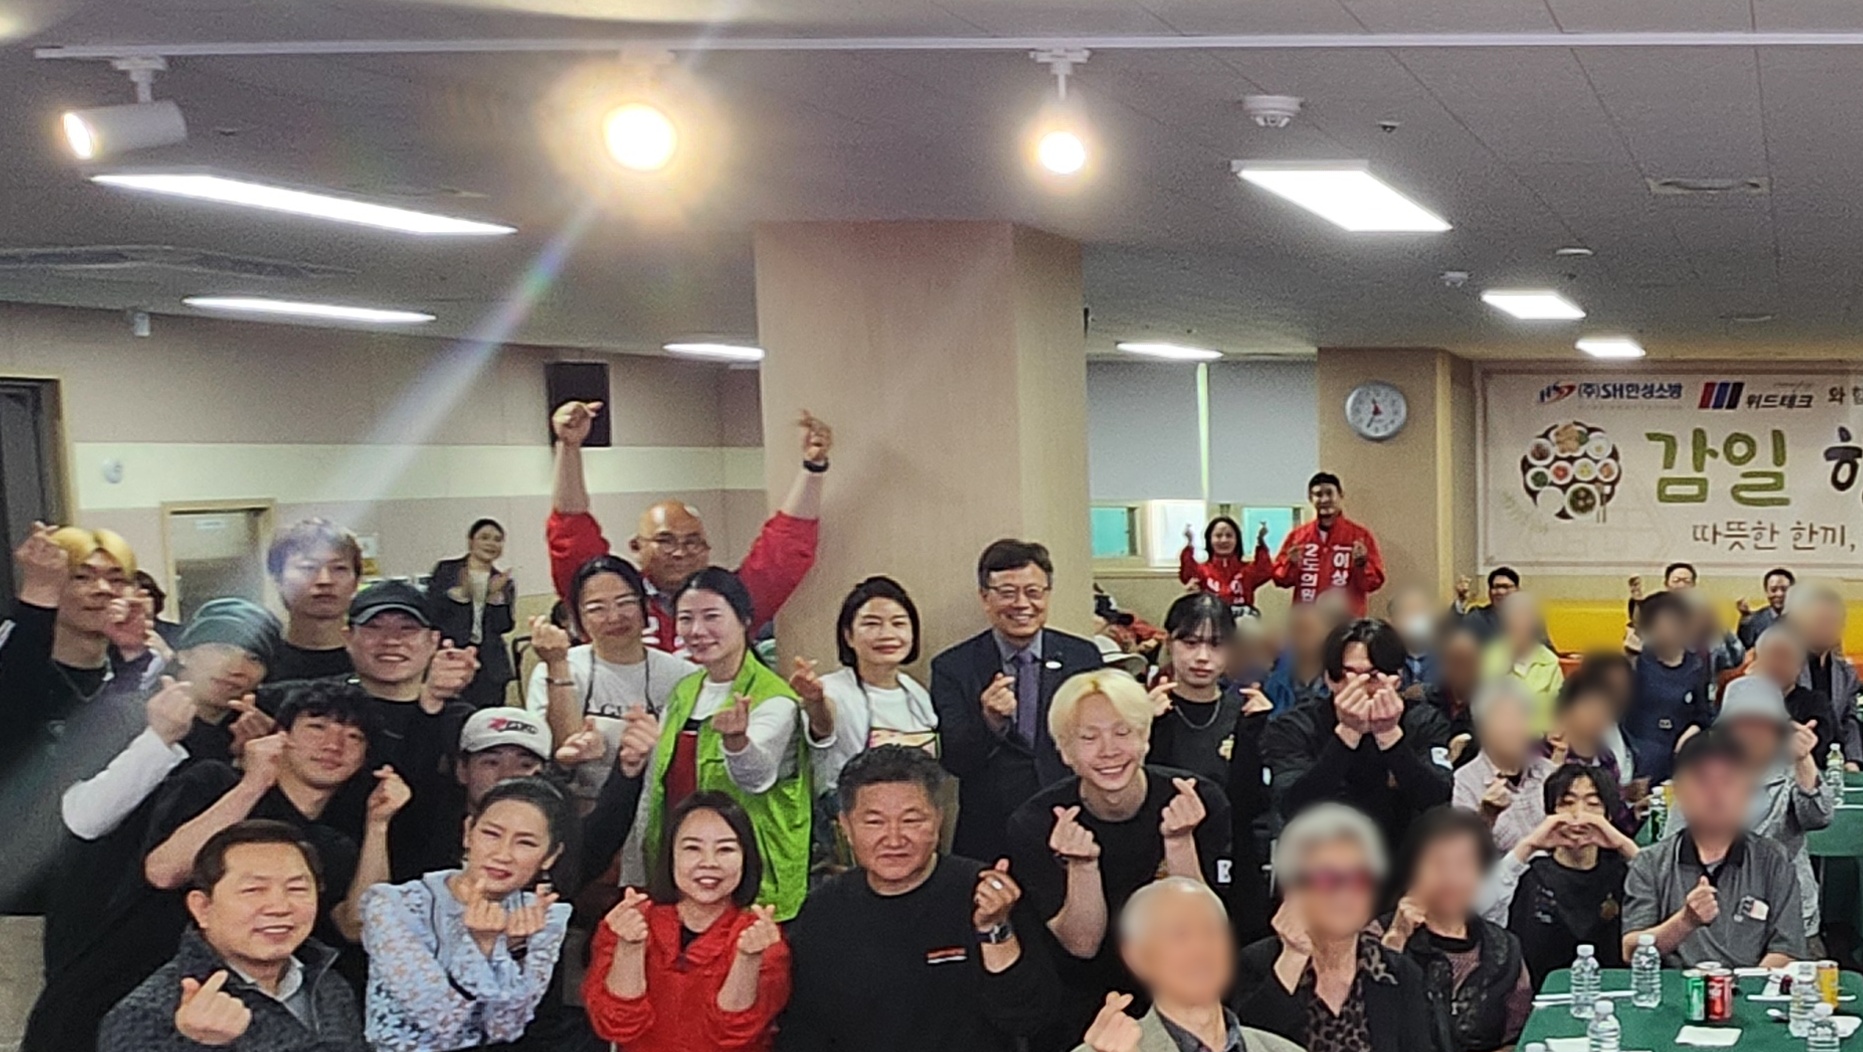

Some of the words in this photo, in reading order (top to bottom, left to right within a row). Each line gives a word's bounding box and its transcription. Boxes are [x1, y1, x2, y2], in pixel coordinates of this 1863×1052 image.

[1746, 393, 1815, 409] 위드테크
[1827, 386, 1846, 404] 와
[1644, 427, 1792, 507] 감일
[1692, 520, 1780, 552] 따뜻한
[1790, 520, 1856, 552] 한끼,
